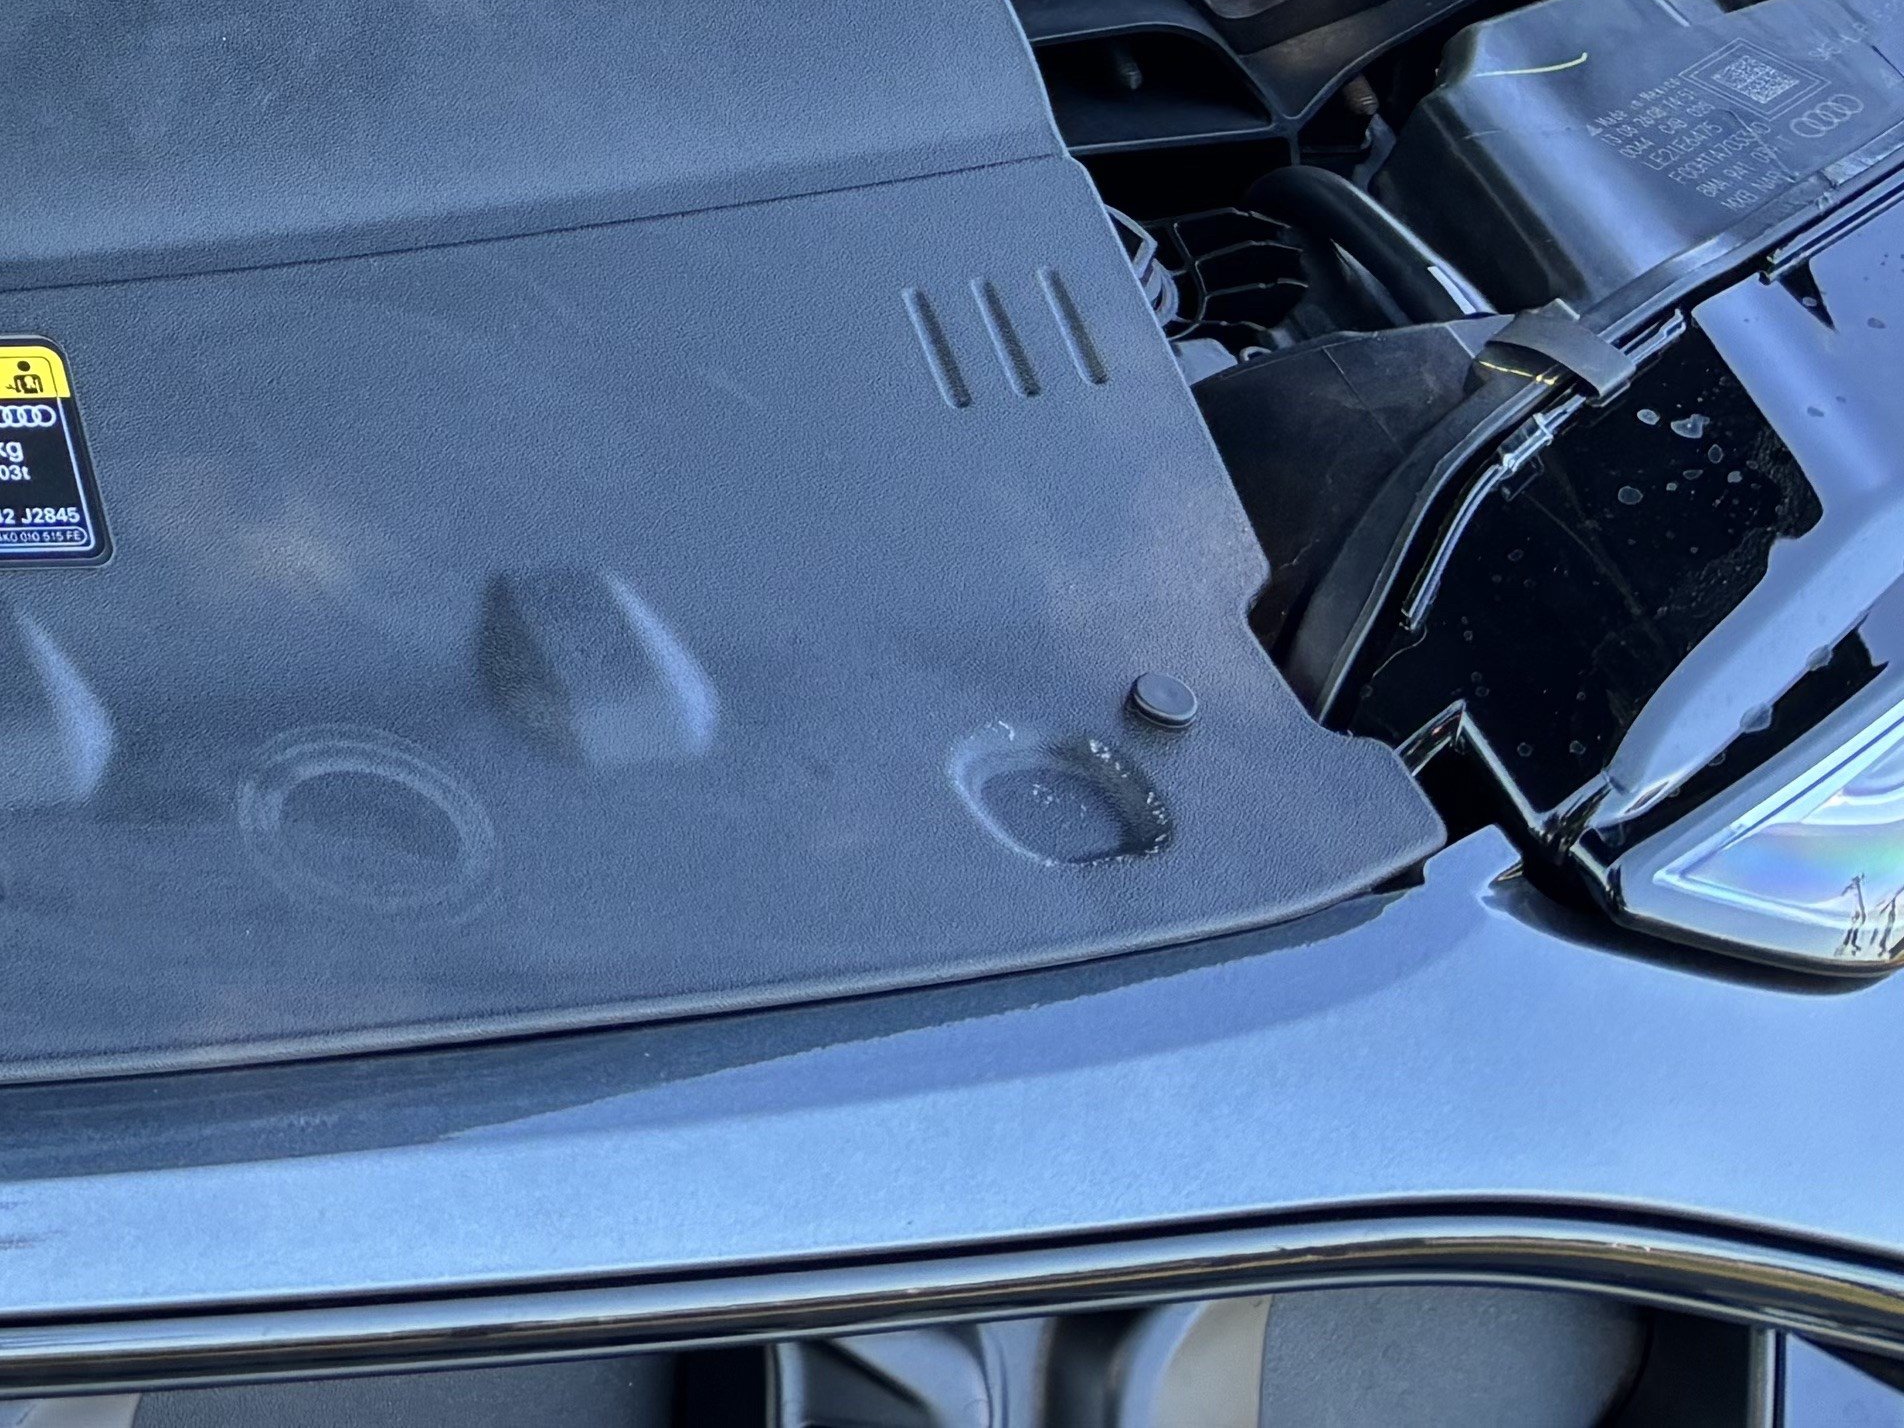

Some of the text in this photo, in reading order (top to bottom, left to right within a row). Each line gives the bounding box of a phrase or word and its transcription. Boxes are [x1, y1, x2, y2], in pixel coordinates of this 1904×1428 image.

[21, 507, 81, 524] J2845
[20, 532, 40, 542] 010
[42, 532, 64, 540] 515
[66, 531, 82, 540] FE
